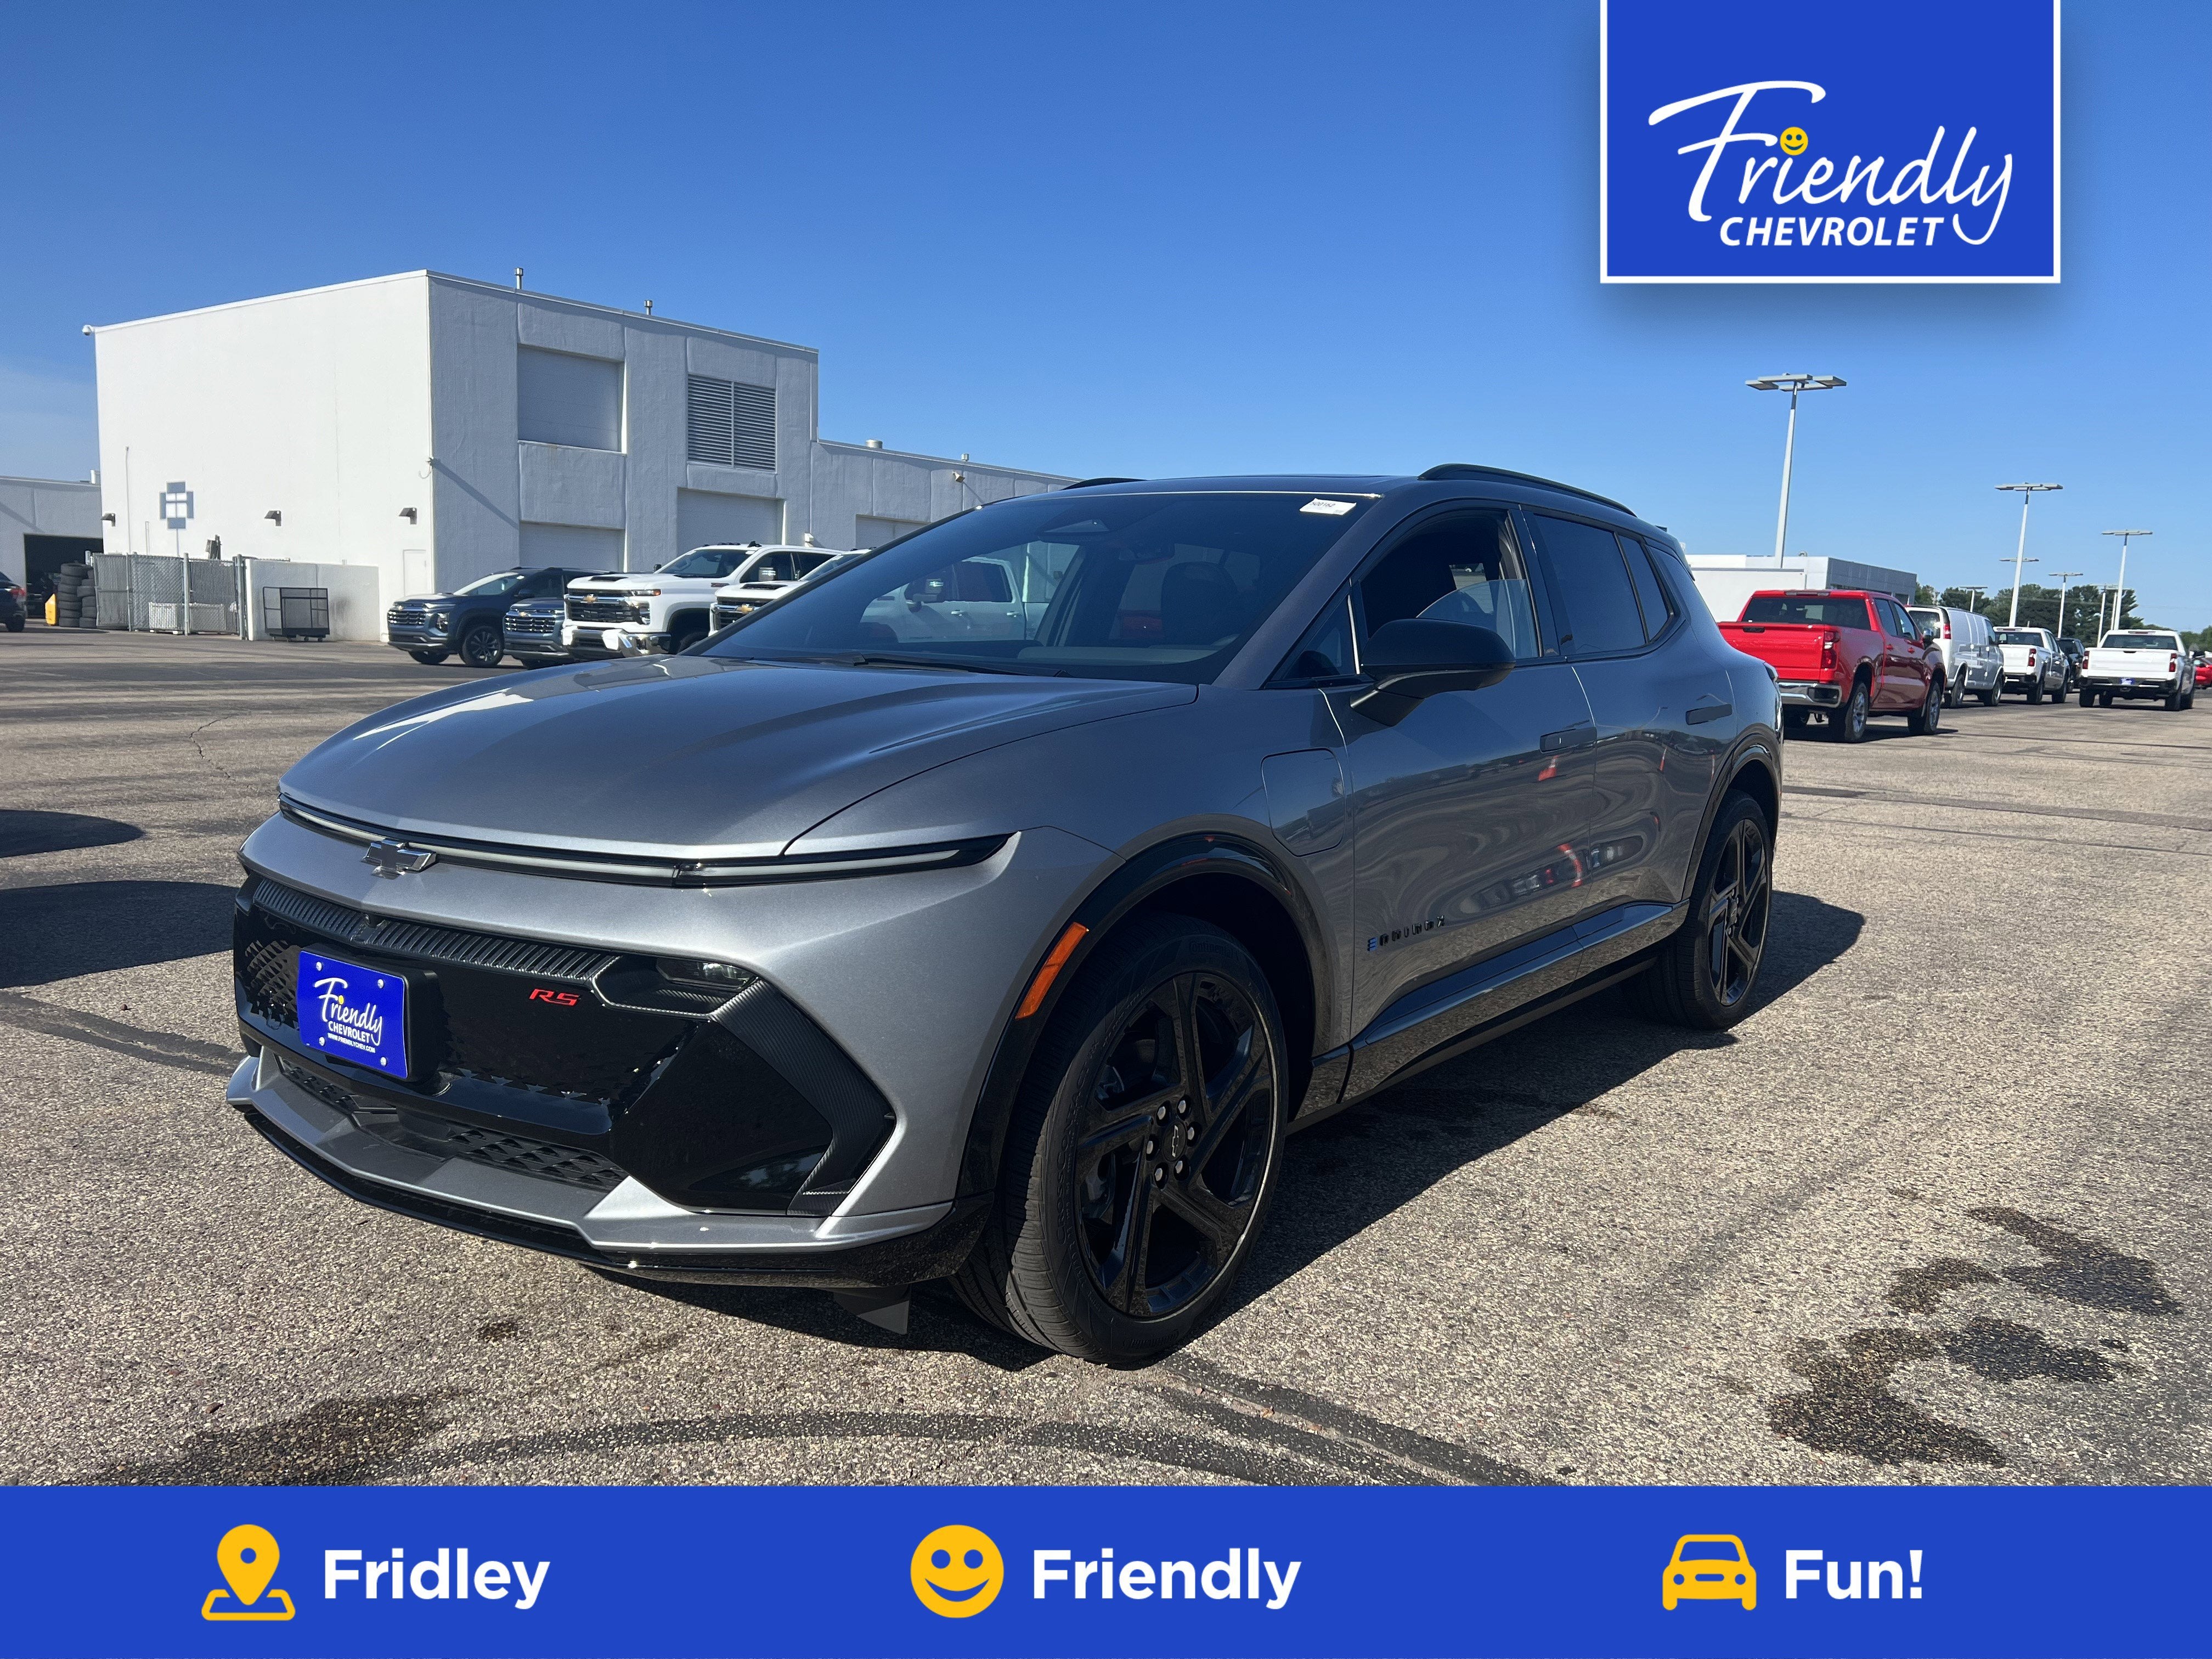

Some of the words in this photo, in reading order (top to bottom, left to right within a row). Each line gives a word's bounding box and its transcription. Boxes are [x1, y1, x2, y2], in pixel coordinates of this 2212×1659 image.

[528, 988, 580, 1007] RS
[314, 978, 382, 1046] Friendly
[328, 1020, 370, 1043] CHEVROLET
